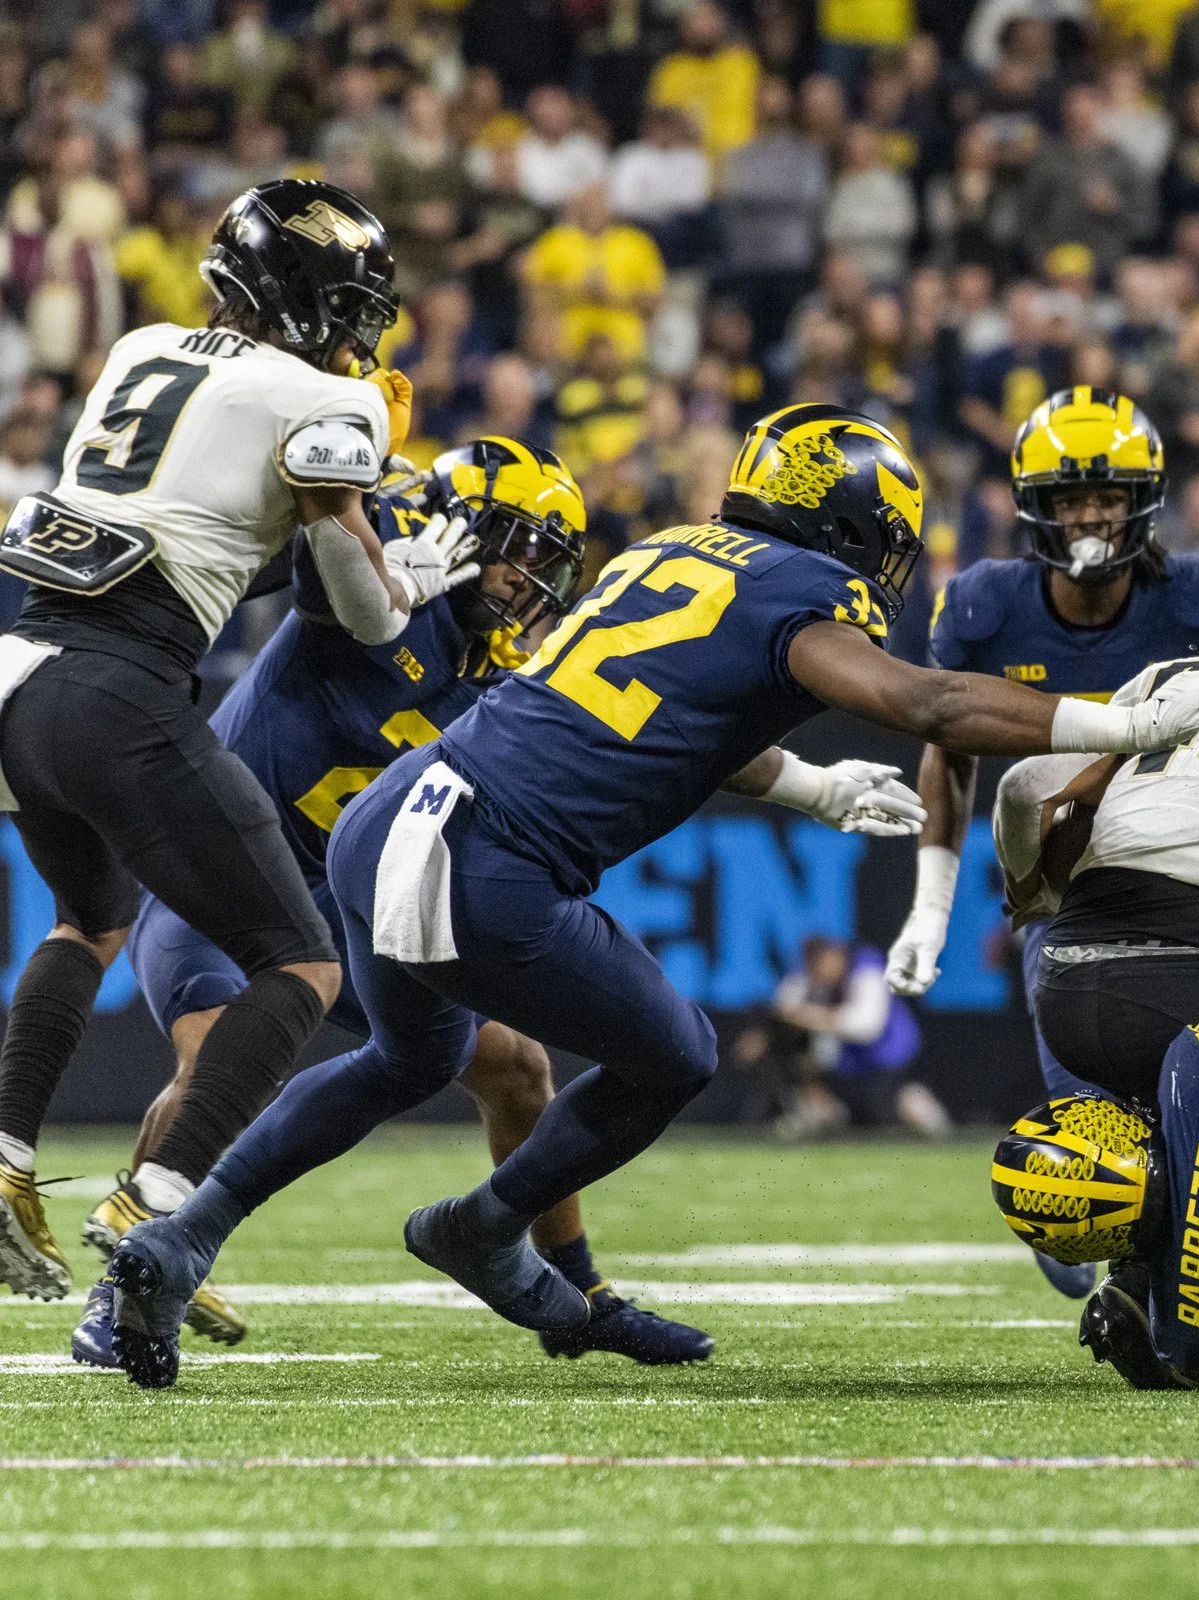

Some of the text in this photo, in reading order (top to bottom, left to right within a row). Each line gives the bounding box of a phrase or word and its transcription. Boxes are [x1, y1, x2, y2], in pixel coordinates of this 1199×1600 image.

[282, 199, 371, 253] P
[75, 356, 212, 497] 9
[22, 518, 98, 554] P
[410, 784, 451, 815] M
